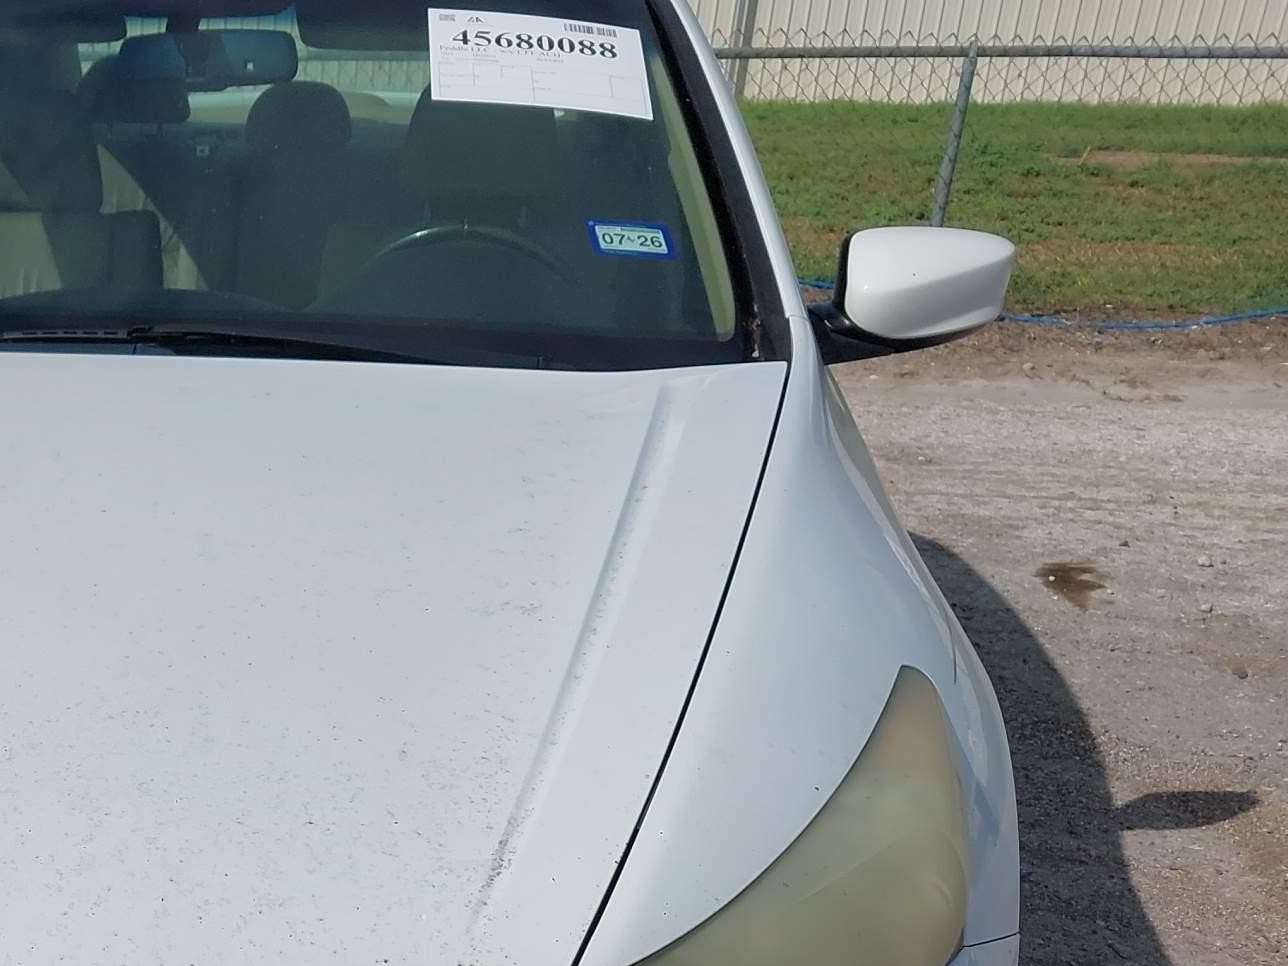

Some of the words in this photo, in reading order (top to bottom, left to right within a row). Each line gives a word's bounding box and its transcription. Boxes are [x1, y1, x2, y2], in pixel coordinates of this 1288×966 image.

[452, 29, 618, 59] 45680088
[602, 232, 626, 245] 07
[637, 234, 663, 248] 26
